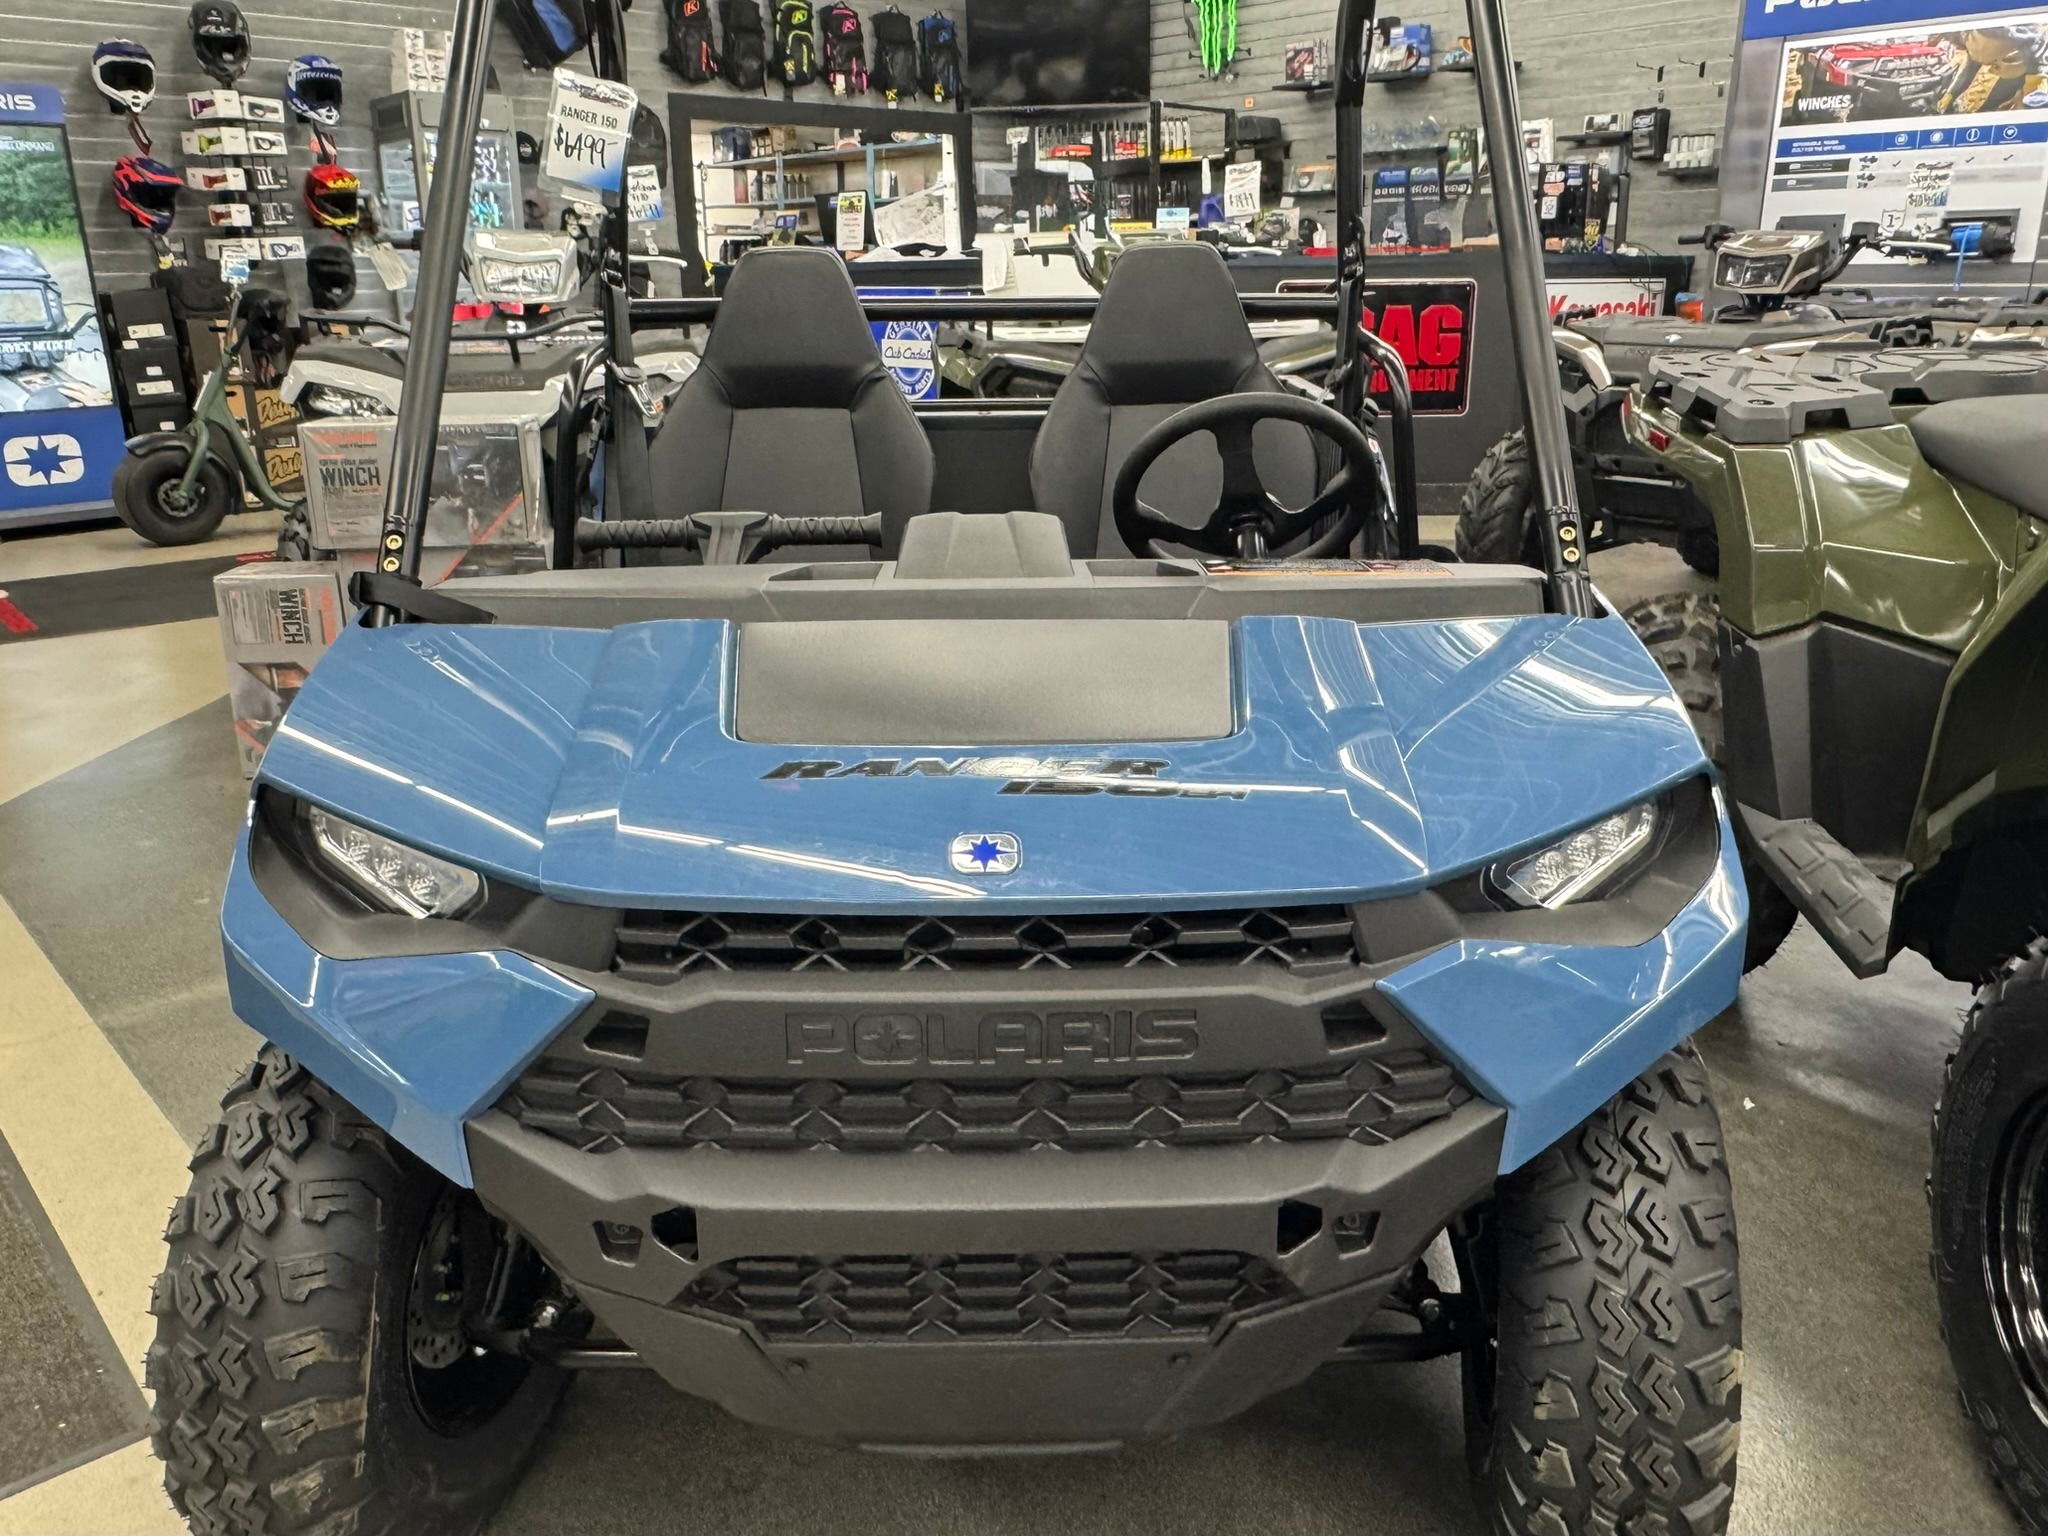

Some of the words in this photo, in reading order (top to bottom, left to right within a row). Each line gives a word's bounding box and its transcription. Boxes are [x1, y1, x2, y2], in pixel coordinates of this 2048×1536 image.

[1798, 94, 1852, 111] WINCHES
[560, 104, 598, 125] RANGER
[601, 115, 618, 129] 150
[319, 466, 381, 487] WINCH
[279, 588, 305, 645] WINCH
[785, 1009, 1199, 1066] POLARIS
